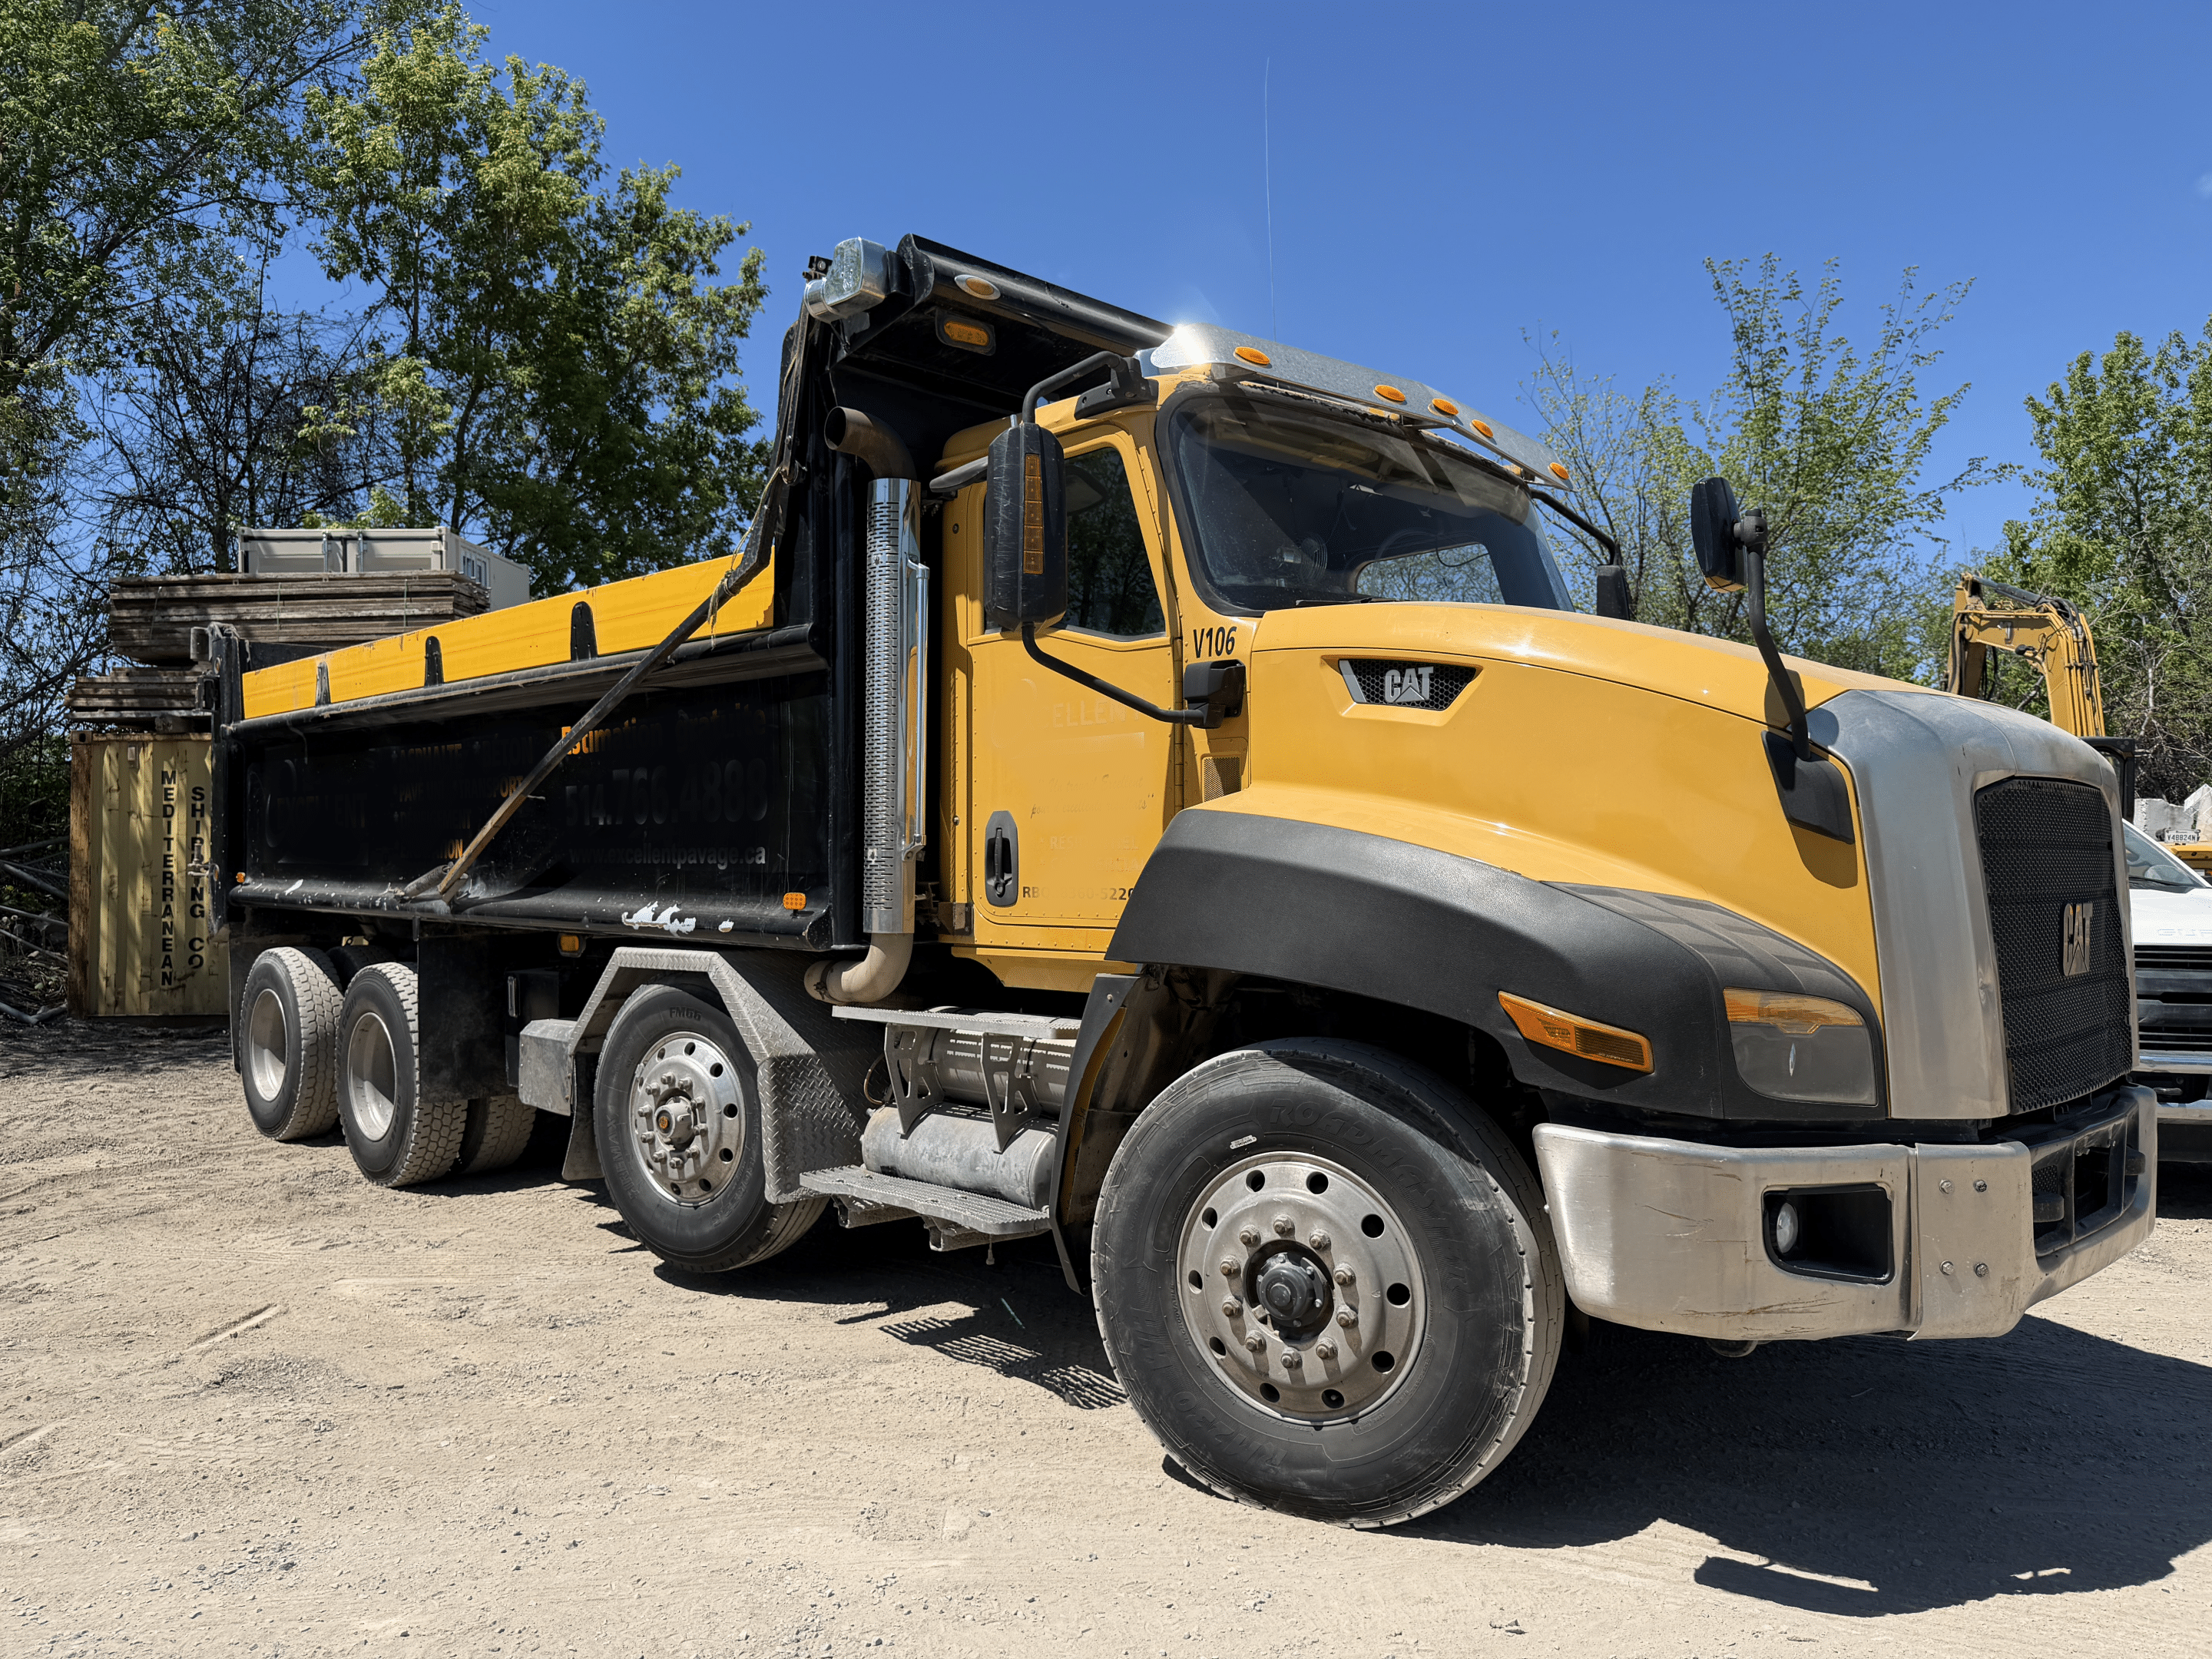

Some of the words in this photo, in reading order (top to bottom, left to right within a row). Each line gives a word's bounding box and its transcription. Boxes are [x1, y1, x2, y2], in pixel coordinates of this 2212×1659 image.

[1193, 626, 1237, 658] V106
[1385, 667, 1434, 703] CAT
[398, 742, 464, 774] ASPHALTE
[481, 733, 535, 768] BÉTON
[399, 777, 425, 803] PAVÉ
[458, 774, 523, 800] TRANSPORT
[565, 757, 768, 827] 514.766.4888
[568, 842, 767, 871] www.excellentpavage.ca
[161, 770, 177, 986] MEDITERRANEAN
[188, 936, 205, 969] CO
[2063, 902, 2094, 976] CAT
